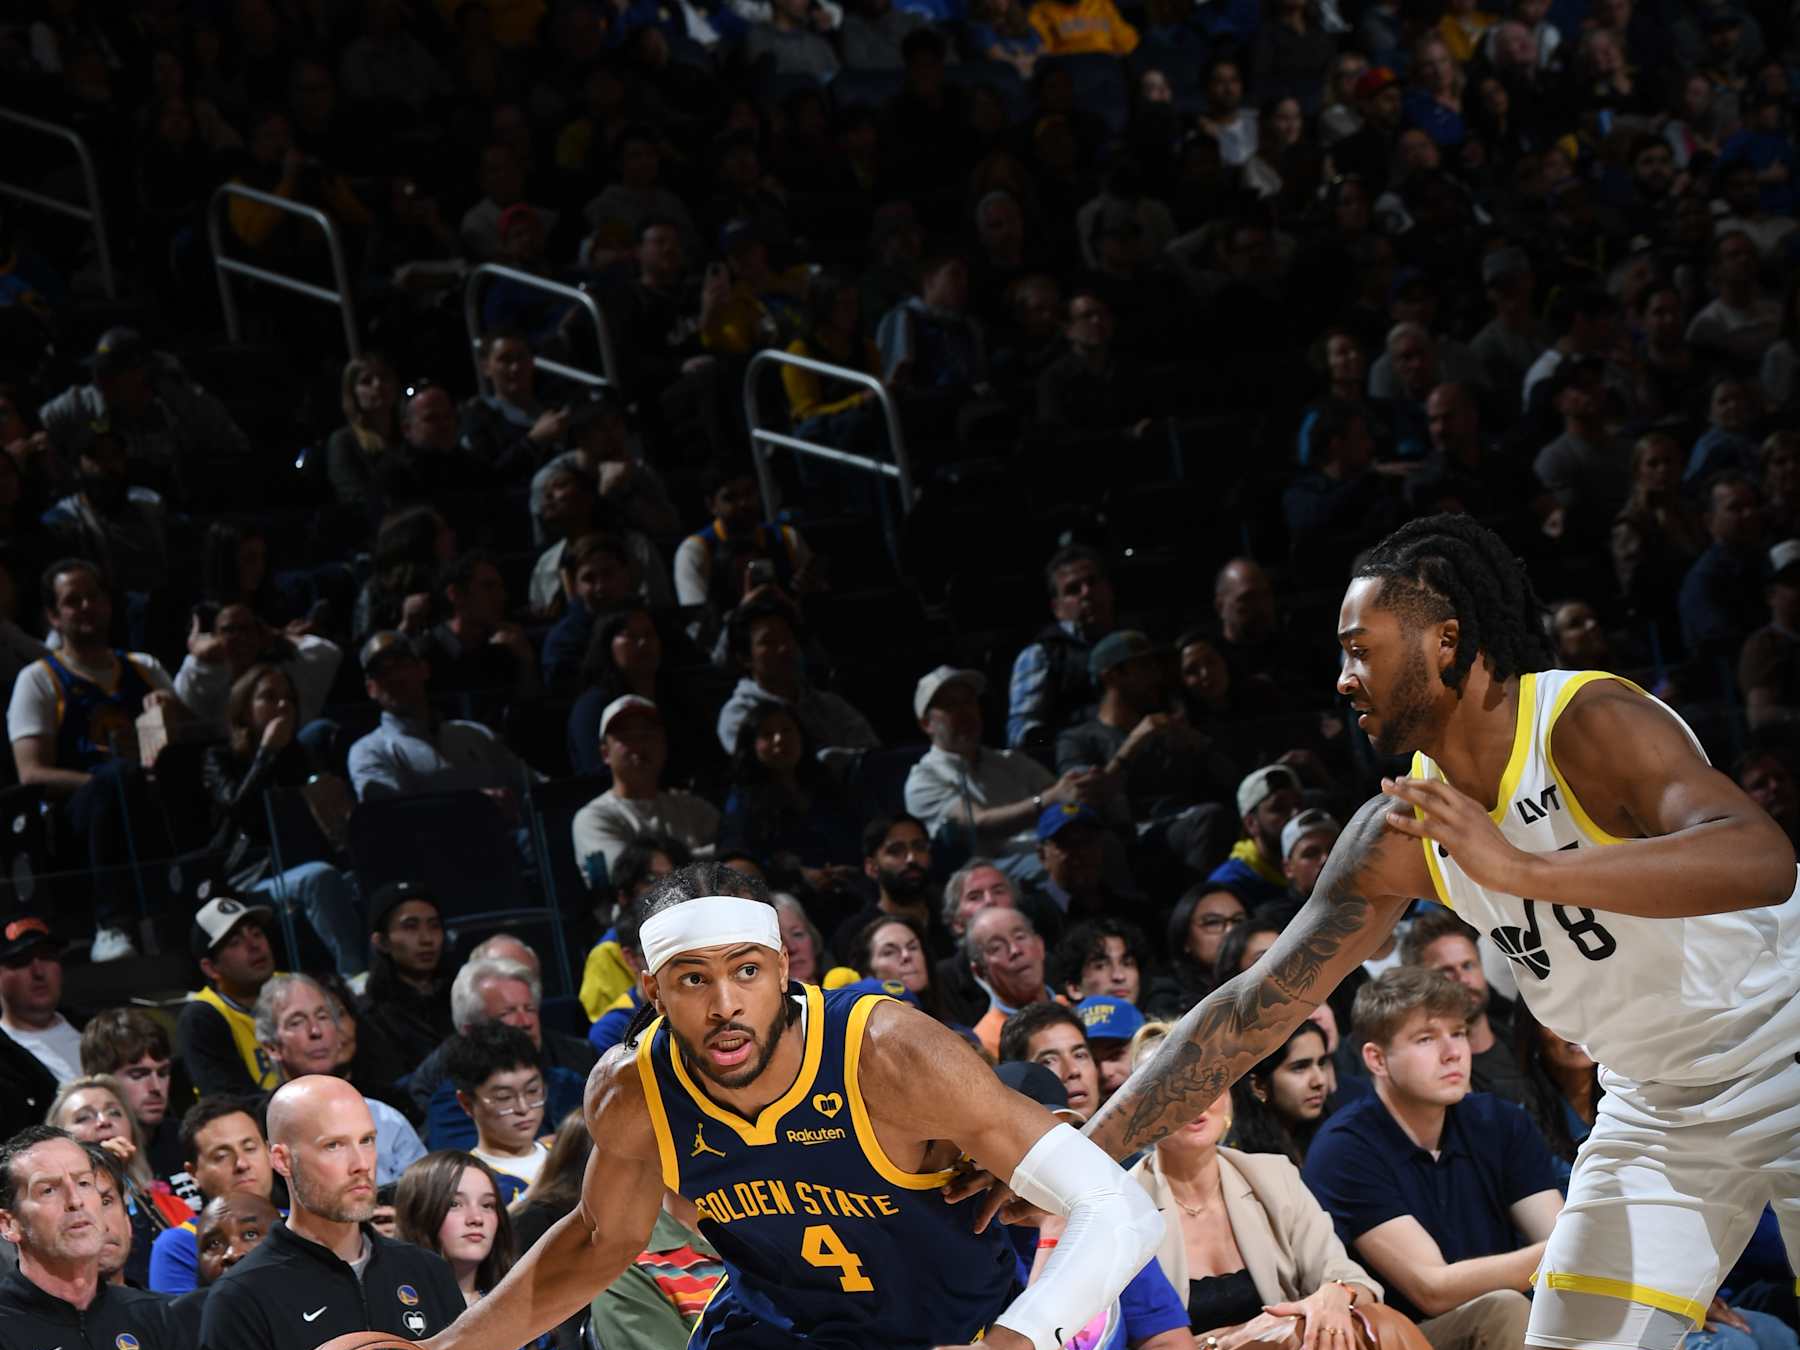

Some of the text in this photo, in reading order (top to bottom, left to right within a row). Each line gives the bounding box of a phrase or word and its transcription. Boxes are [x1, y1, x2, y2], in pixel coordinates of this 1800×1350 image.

[820, 1098, 838, 1112] DM
[786, 1127, 846, 1143] Rakuten
[694, 1180, 900, 1224] GOLDEN STATE
[800, 1224, 875, 1293] 4
